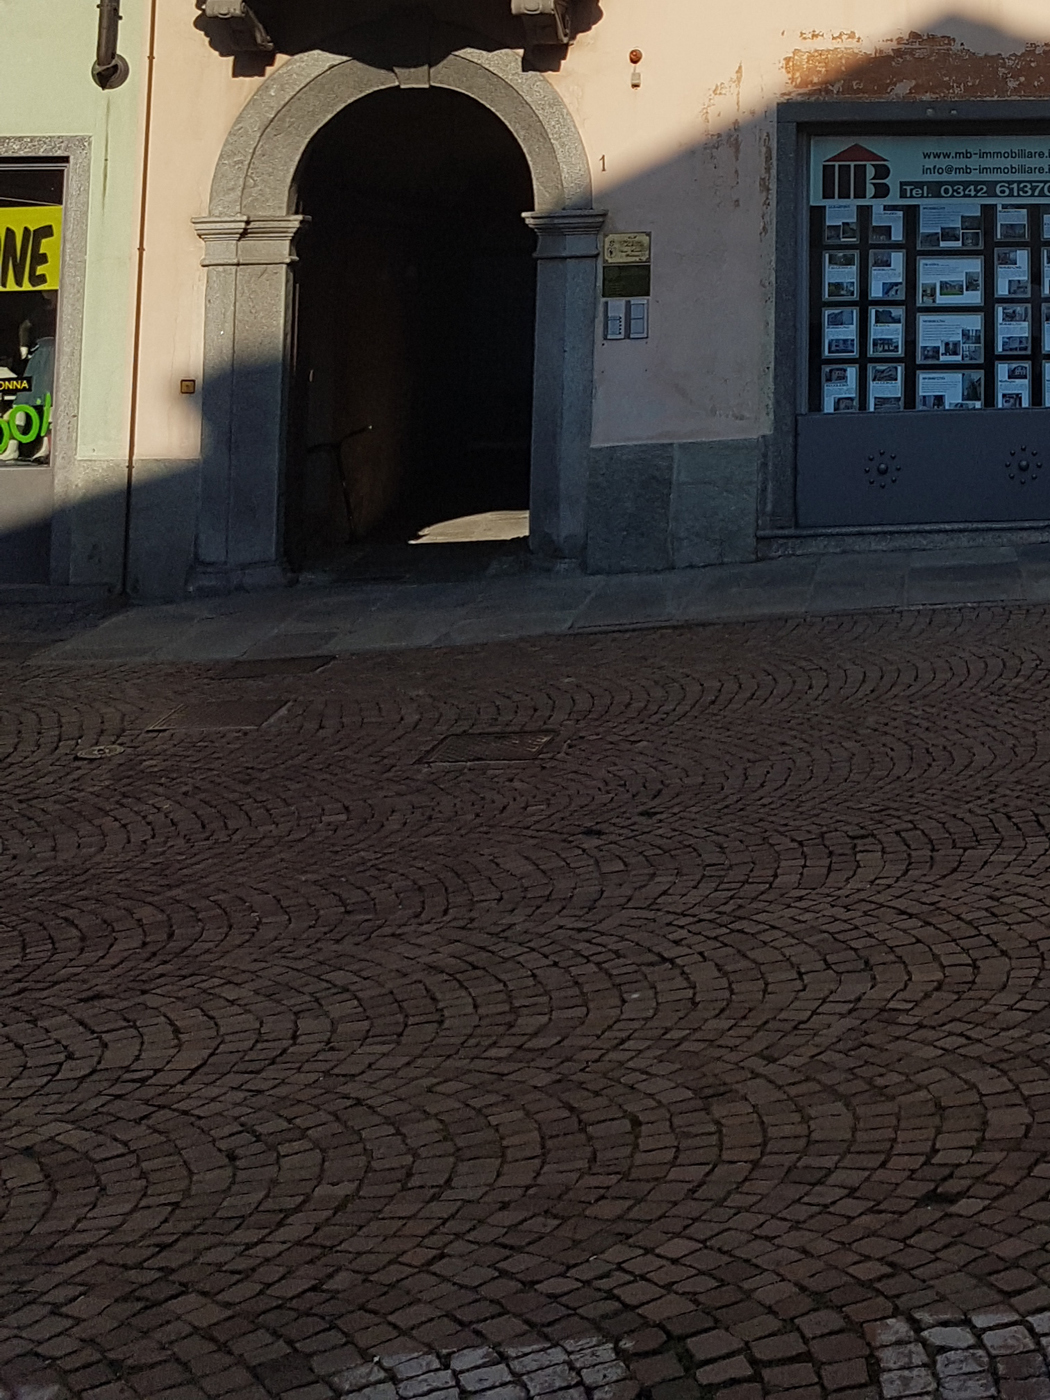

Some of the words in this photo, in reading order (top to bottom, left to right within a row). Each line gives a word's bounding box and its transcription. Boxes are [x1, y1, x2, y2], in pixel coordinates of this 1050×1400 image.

[903, 185, 932, 198] Tel.
[940, 184, 988, 197] 0342
[0, 224, 54, 289] NE
